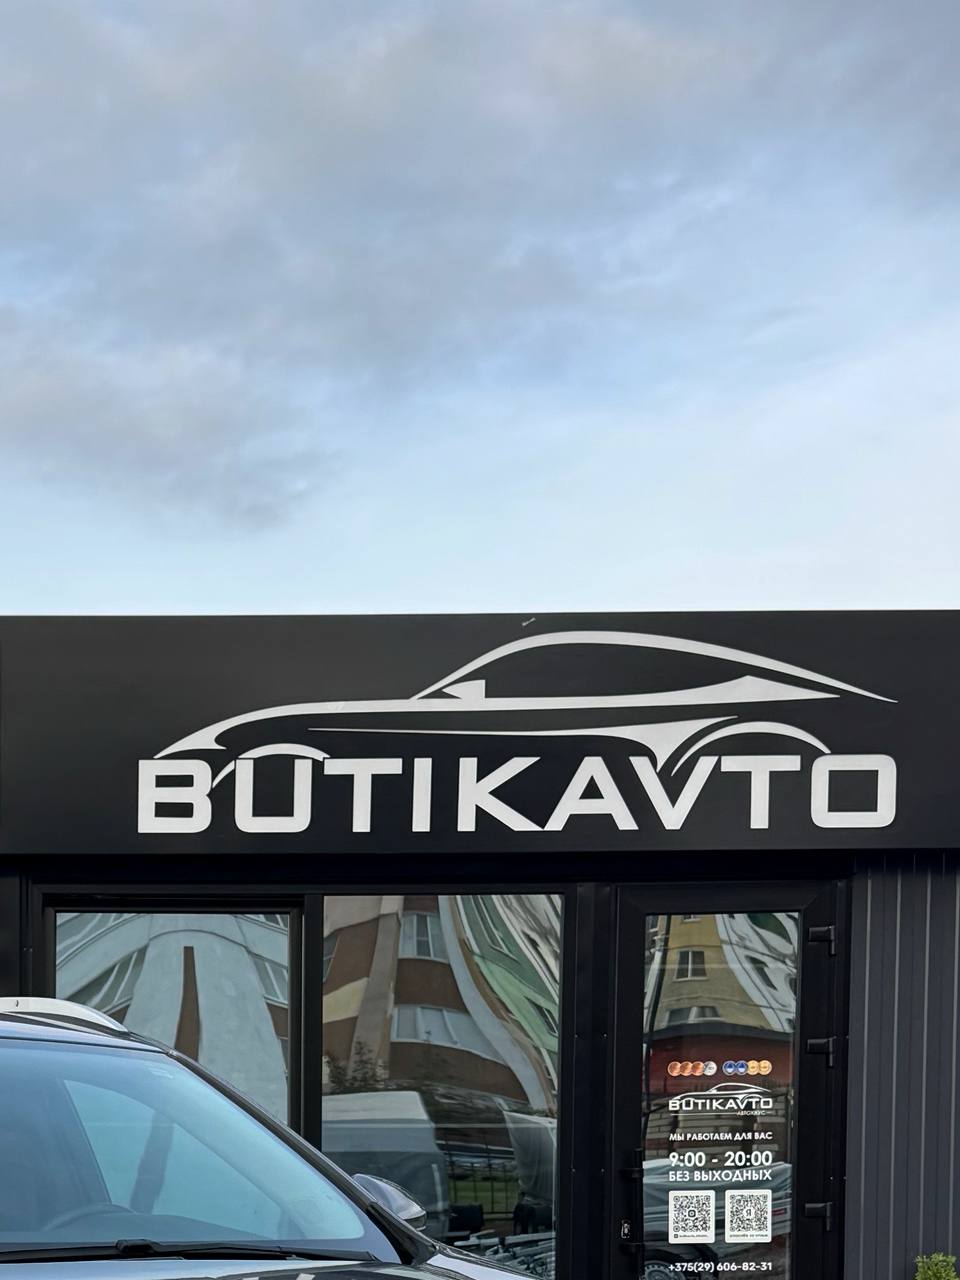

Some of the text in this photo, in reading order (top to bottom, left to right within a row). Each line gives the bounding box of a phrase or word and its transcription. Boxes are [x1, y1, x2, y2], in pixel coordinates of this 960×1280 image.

[137, 753, 898, 834] BUTIKAVTO
[668, 1097, 773, 1111] BUTIKAVTO
[669, 1132, 773, 1141] МЫ РАБОТАЕМ ДЛЯ ВАС
[669, 1151, 706, 1167] 9:00
[724, 1150, 773, 1167] 20:00
[669, 1169, 772, 1182] БЕЗ ВЫХОДНЫХ
[668, 1261, 772, 1273] +375(29) 606-82-31
